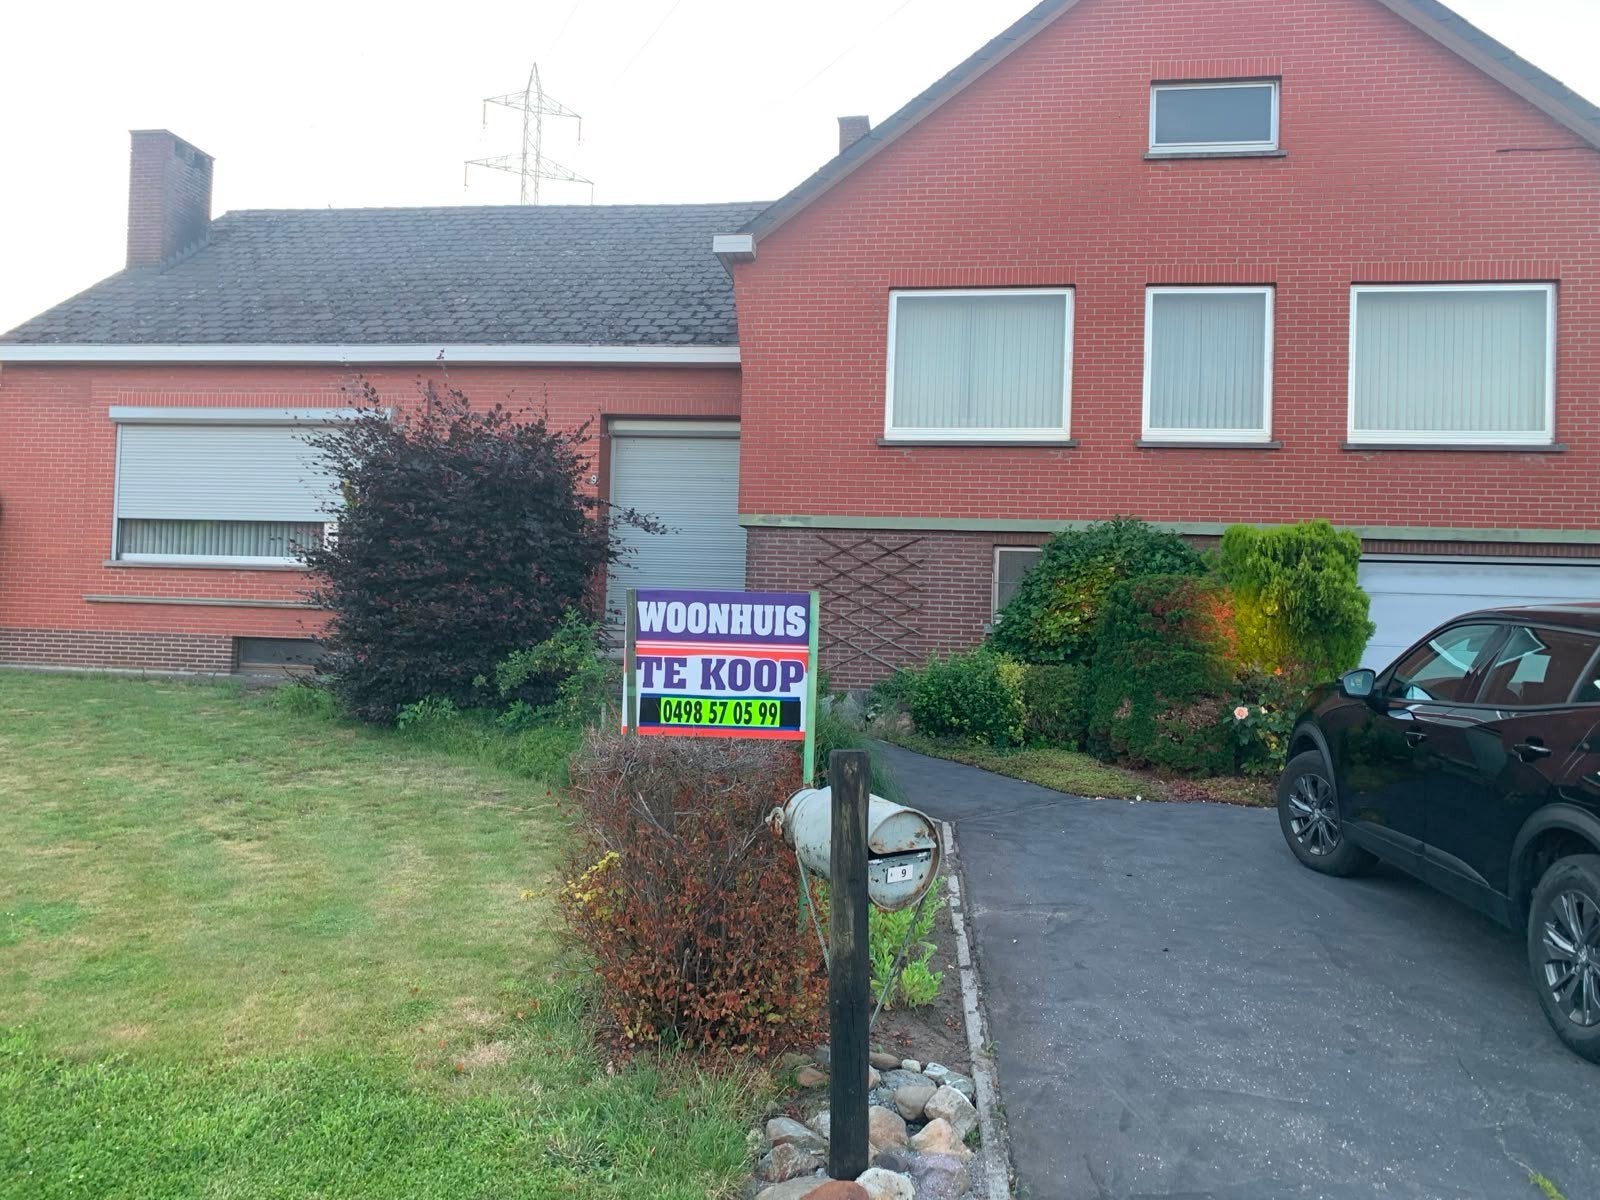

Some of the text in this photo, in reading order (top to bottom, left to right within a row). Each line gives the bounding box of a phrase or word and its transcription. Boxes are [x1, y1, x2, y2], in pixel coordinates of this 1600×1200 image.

[637, 601, 806, 637] WOONHUIS
[636, 656, 804, 693] TE KOOP
[663, 699, 778, 726] 0498 57 05 99
[901, 868, 907, 878] 9
